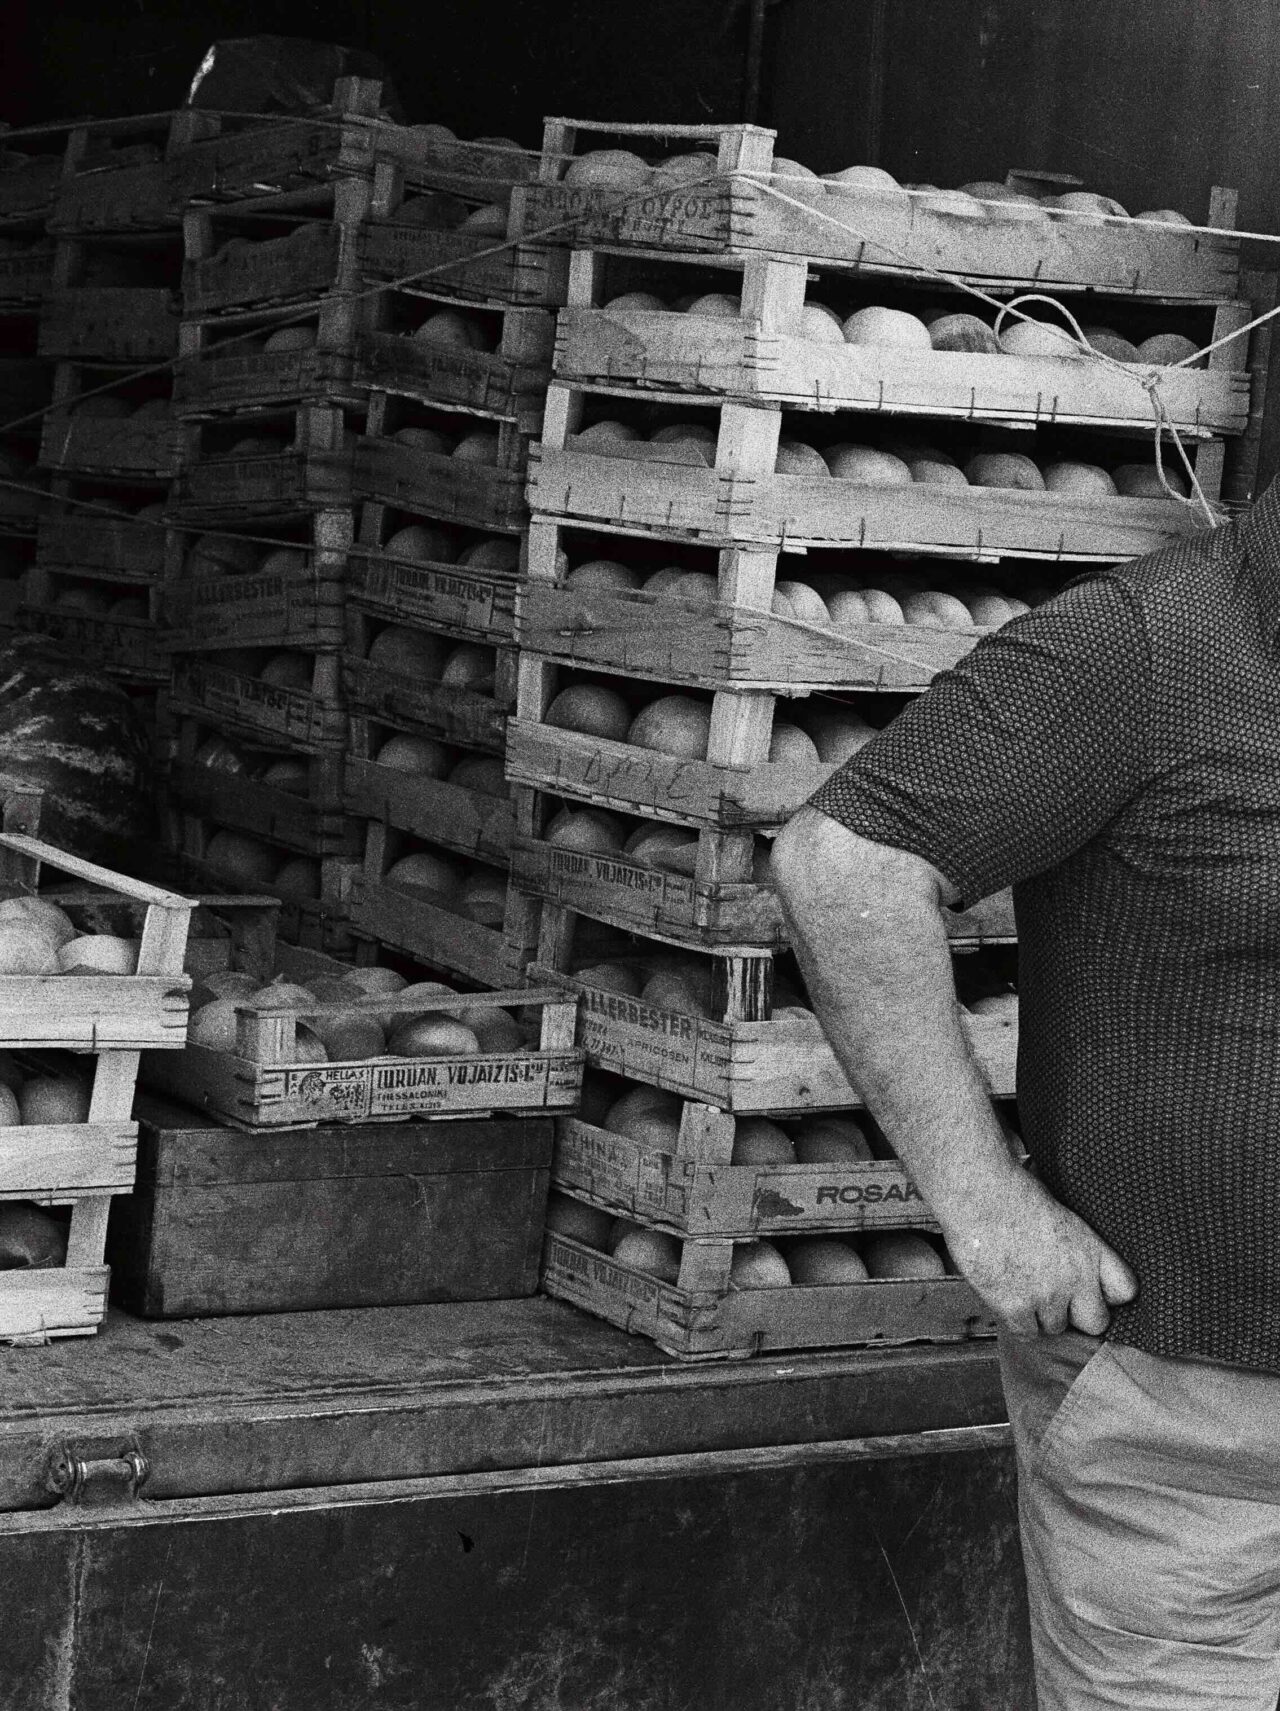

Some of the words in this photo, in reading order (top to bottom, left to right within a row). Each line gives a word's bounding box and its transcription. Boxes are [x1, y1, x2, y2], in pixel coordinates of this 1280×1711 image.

[577, 989, 692, 1041] ALLERBESTER
[626, 1037, 690, 1064] APRICOSEN
[326, 1069, 365, 1081] HELLAS
